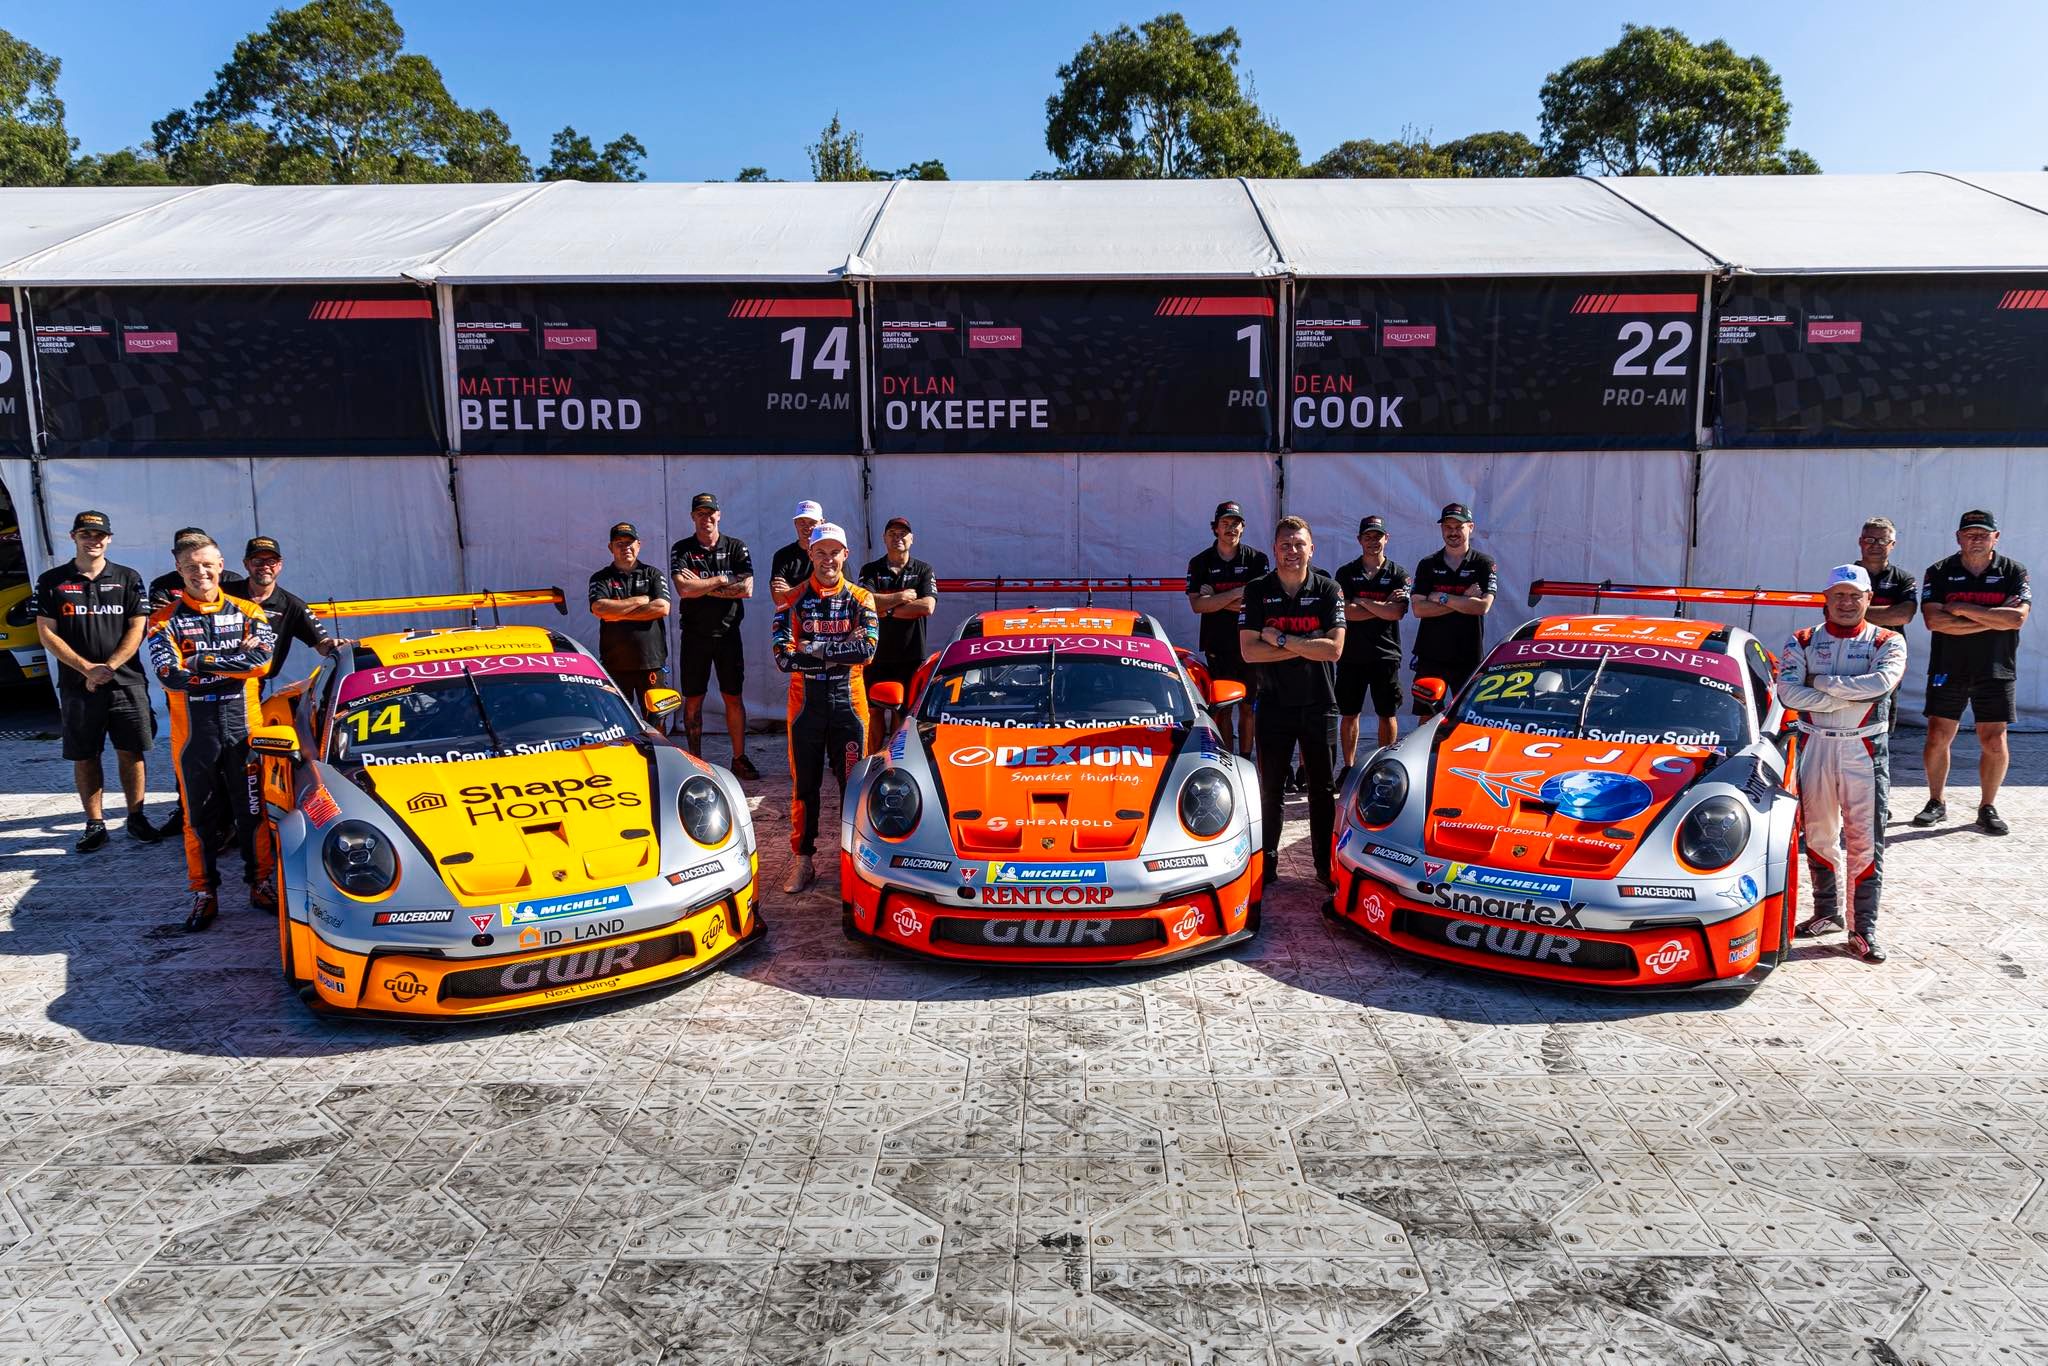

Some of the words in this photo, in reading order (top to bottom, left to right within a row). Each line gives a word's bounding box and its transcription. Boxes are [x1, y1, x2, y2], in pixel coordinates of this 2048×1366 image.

[882, 320, 948, 328] PORSCHE
[781, 326, 850, 380] 14
[1237, 324, 1261, 378] 1
[1612, 320, 1693, 376] 22
[460, 376, 574, 396] MATTHEW
[882, 376, 955, 395] DYLAN
[1295, 375, 1353, 393] DEAN
[767, 392, 850, 410] PRO-AM
[1227, 389, 1268, 407] PRO
[1602, 388, 1687, 406] PRO-AM
[460, 398, 642, 431] BELFORD
[885, 399, 1049, 431] O'KEEFFE
[1292, 395, 1404, 428] COOK
[413, 642, 542, 658] ShapeHomes
[1120, 656, 1170, 674] O'Keeffe
[558, 673, 603, 687] Belford
[944, 674, 964, 704] 1
[1474, 671, 1535, 703] 22
[1699, 676, 1734, 693] Cook
[346, 703, 406, 742] 14
[939, 712, 1001, 728] Porsche
[1129, 711, 1174, 726] South
[1464, 709, 1522, 733] Porsche
[1587, 728, 1660, 745] Sydney
[1662, 731, 1721, 745] South
[361, 752, 443, 767] Porsche
[515, 736, 581, 758] Sydney
[582, 724, 627, 745] South
[995, 745, 1154, 768] DEXION
[1010, 771, 1072, 783] Smarter
[1081, 771, 1144, 786] thinking.
[458, 774, 613, 805] Shape
[465, 791, 643, 826] Homes
[1015, 818, 1113, 828] SHEARGOLD
[1438, 820, 1494, 832] Australian
[1496, 825, 1553, 839] Corporate
[1556, 833, 1576, 843] Jet
[1577, 836, 1622, 851] Centres
[901, 857, 949, 871] RACEBORN
[1158, 855, 1206, 870] RACEBORN
[1372, 846, 1416, 865] RACEBORN
[679, 861, 722, 881] RACEBORN
[1020, 868, 1097, 878] MICHELIN
[1480, 875, 1561, 892] MICHELIN
[1634, 886, 1693, 899] RACEBORN
[540, 893, 620, 915] MICHELIN
[981, 885, 1114, 905] RENTCORP
[1363, 898, 1386, 922] GWR
[1432, 881, 1589, 930] SmarteX
[388, 911, 452, 923] RACEBORN
[892, 911, 923, 933] GWR
[1172, 913, 1206, 934] GWR
[701, 919, 725, 945] GWR
[982, 918, 1113, 943] GWR
[1445, 919, 1582, 963] GWR
[500, 942, 640, 991] GWR
[1644, 949, 1691, 966] GWR
[383, 978, 429, 996] GWR
[543, 987, 576, 999] Next
[579, 979, 617, 992] Living
